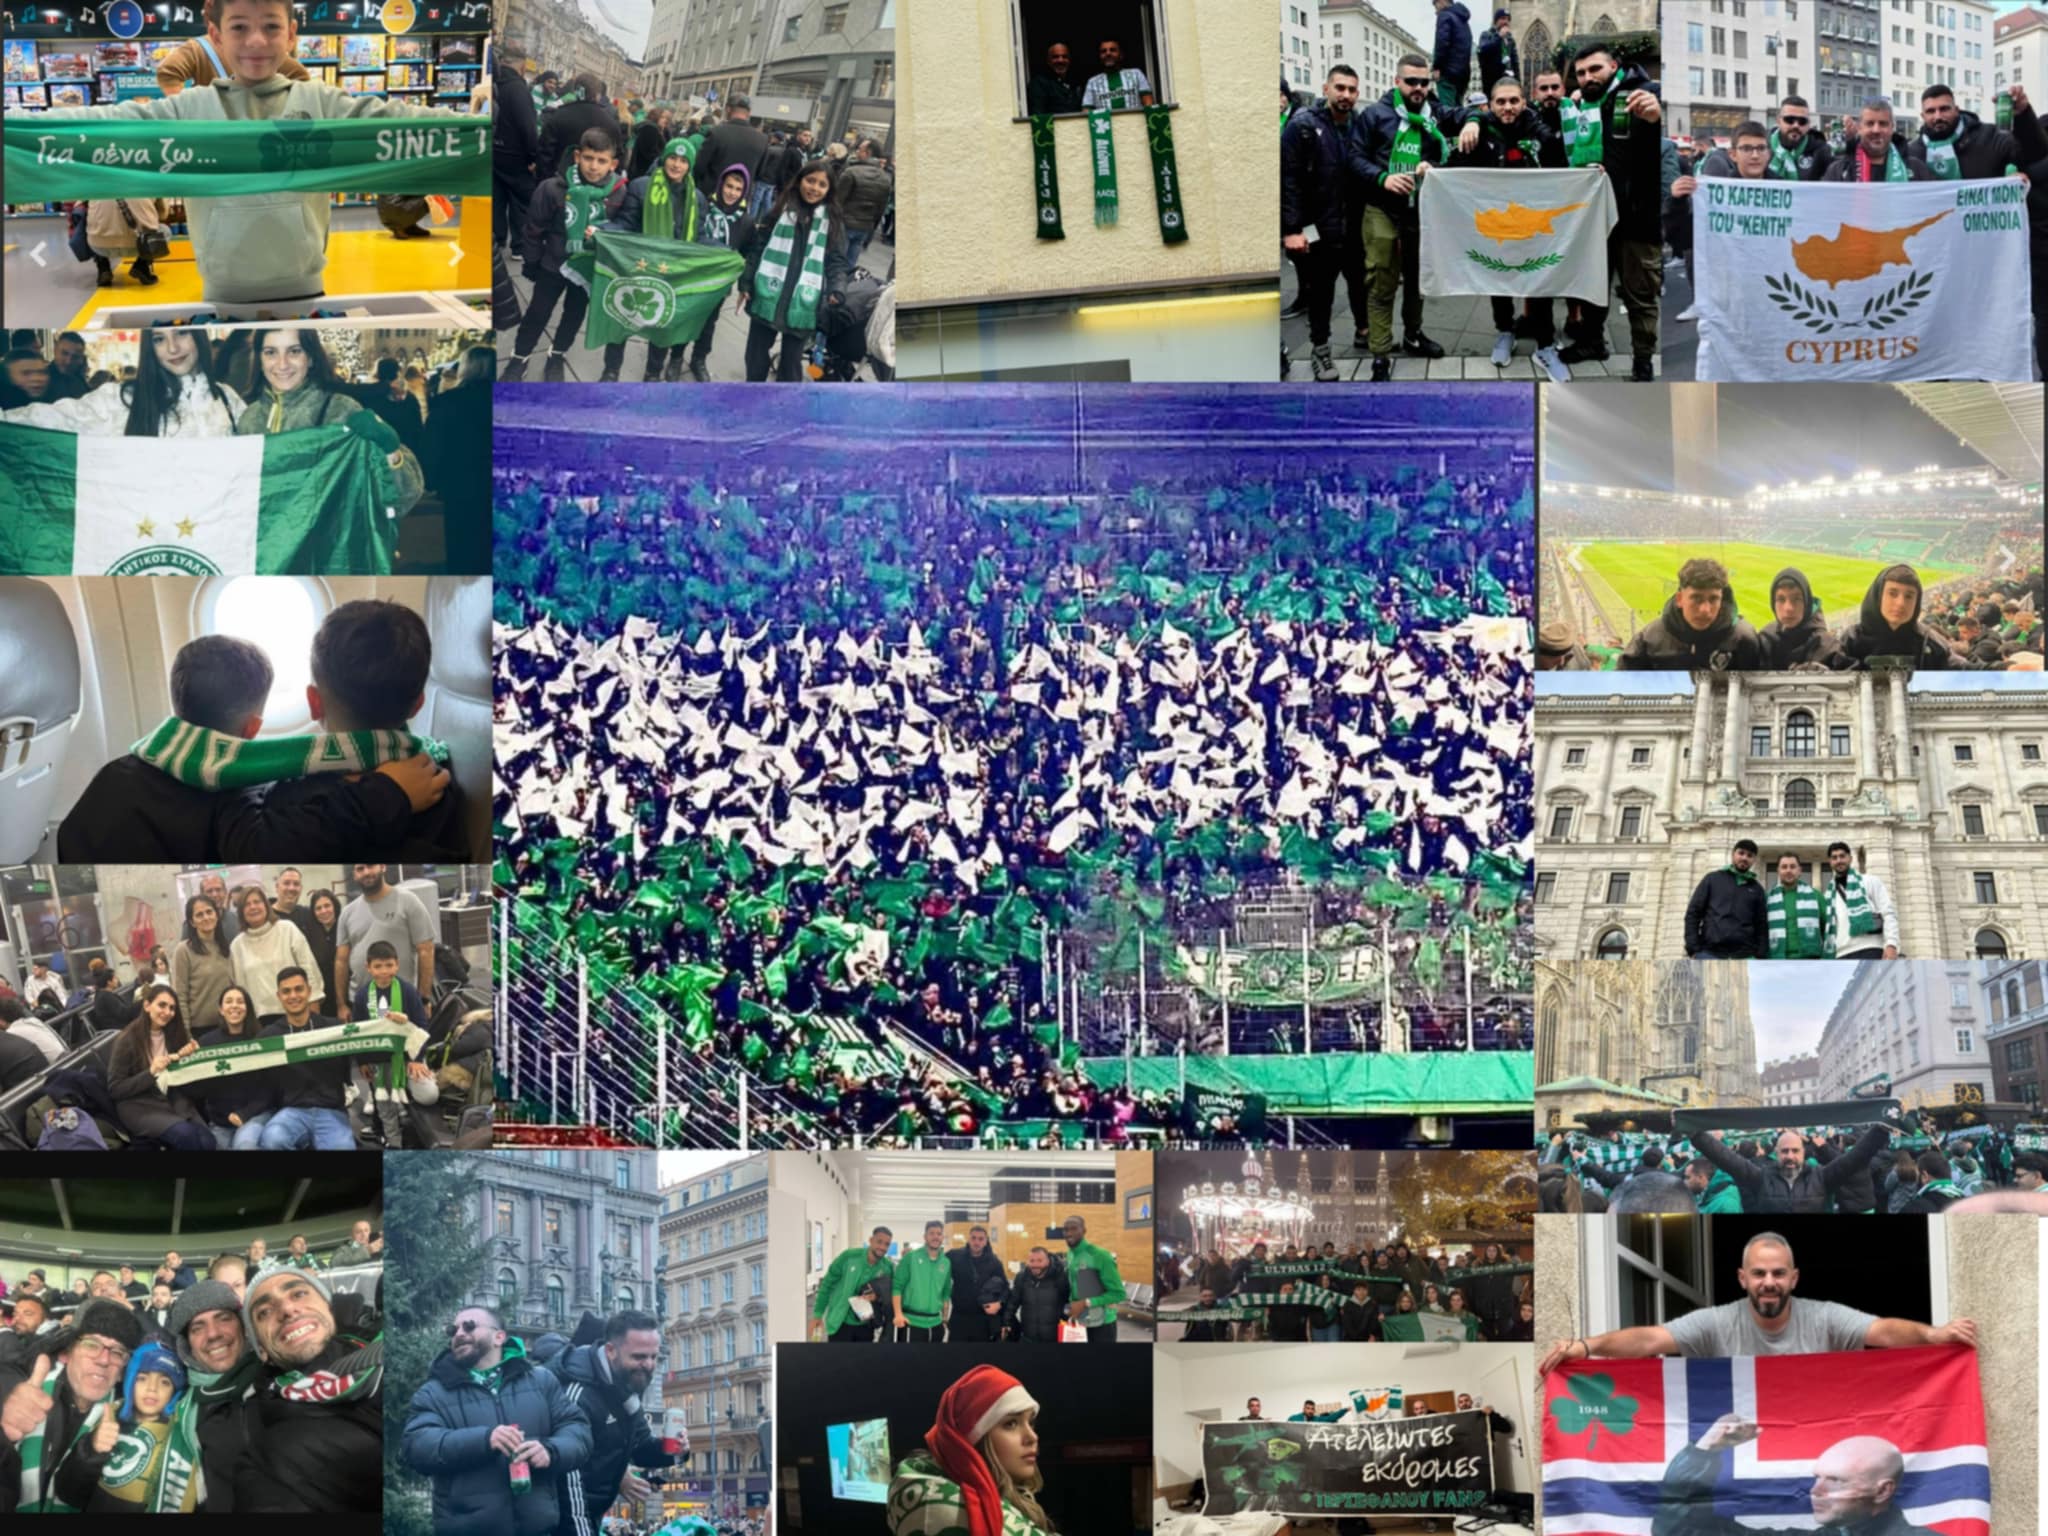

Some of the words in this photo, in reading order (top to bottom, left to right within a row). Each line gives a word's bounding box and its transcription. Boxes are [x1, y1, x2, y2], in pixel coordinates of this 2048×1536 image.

[375, 127, 462, 161] SINCE
[1707, 183, 1724, 205] TO
[1727, 186, 1792, 209] KAFENEIO
[1956, 187, 1989, 206] EINAI
[1708, 211, 1734, 233] TOU
[1963, 209, 2022, 232] OMONOIA
[1785, 335, 1920, 364] CYPRUS
[179, 1042, 262, 1065] OMONOIA
[306, 1037, 394, 1057] OMONOIA
[1264, 1264, 1310, 1274] ULTRAS
